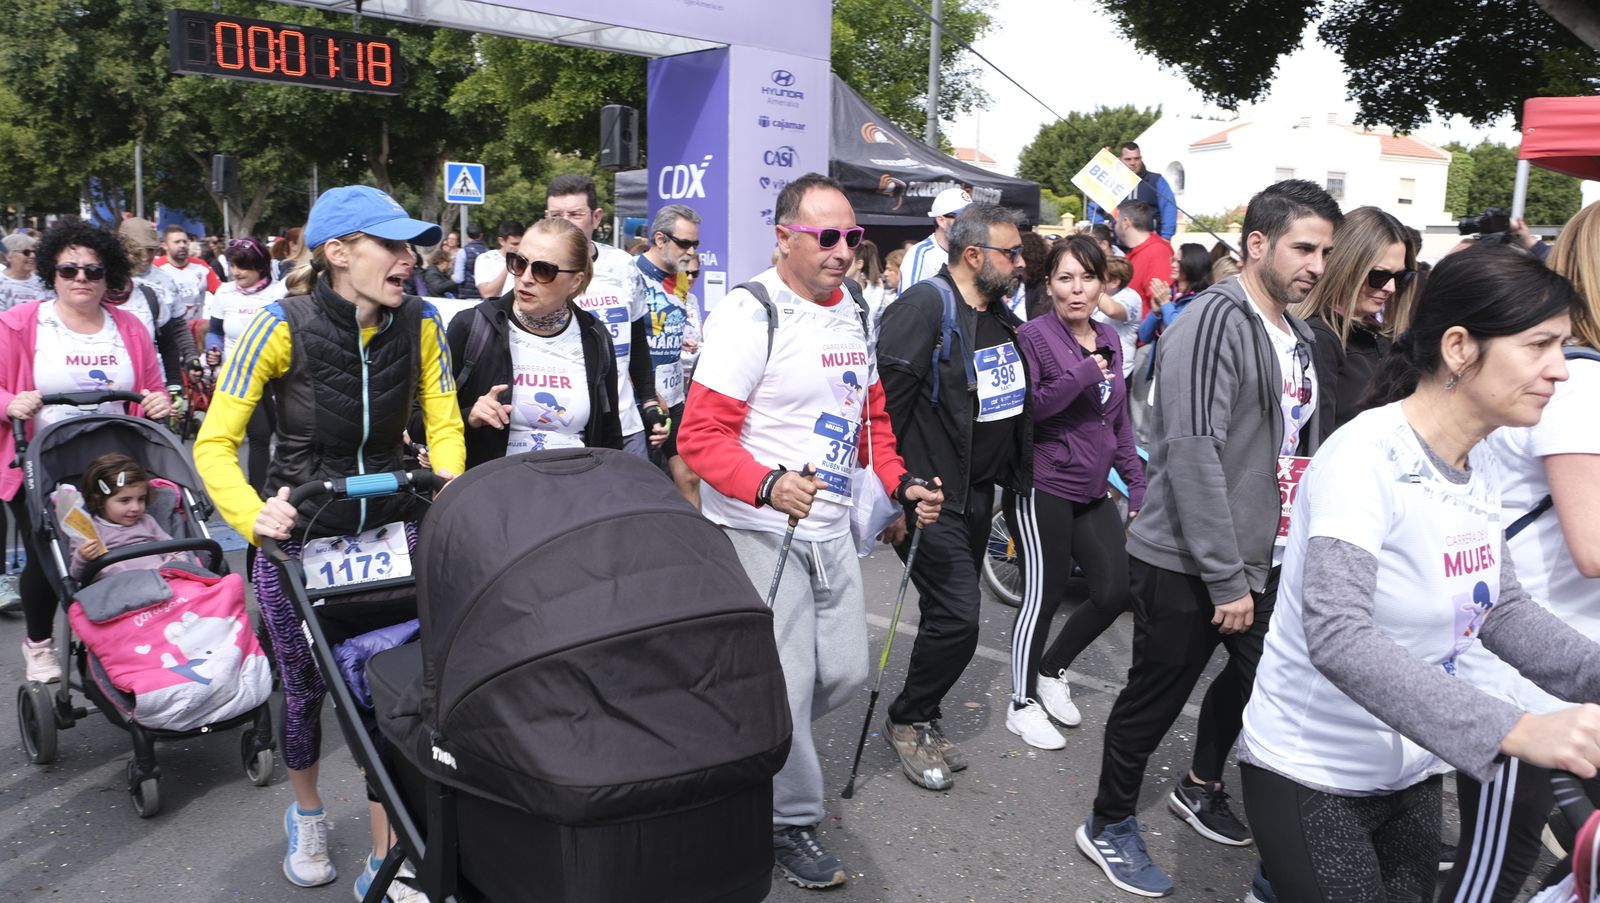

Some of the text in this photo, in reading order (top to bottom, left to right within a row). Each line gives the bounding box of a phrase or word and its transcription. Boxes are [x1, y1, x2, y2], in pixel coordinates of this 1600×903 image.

[761, 86, 804, 99] HYUNDAI
[772, 119, 806, 130] cajamar
[764, 150, 793, 167] CASI
[658, 155, 713, 199] CDX
[579, 296, 619, 308] MUJER
[66, 355, 118, 366] MUJER
[821, 352, 867, 367] MUJER
[513, 374, 572, 389] MUJER
[991, 364, 1016, 387] 398
[826, 440, 856, 468] 370
[320, 551, 393, 586] 1173
[1443, 543, 1496, 578] MUJER
